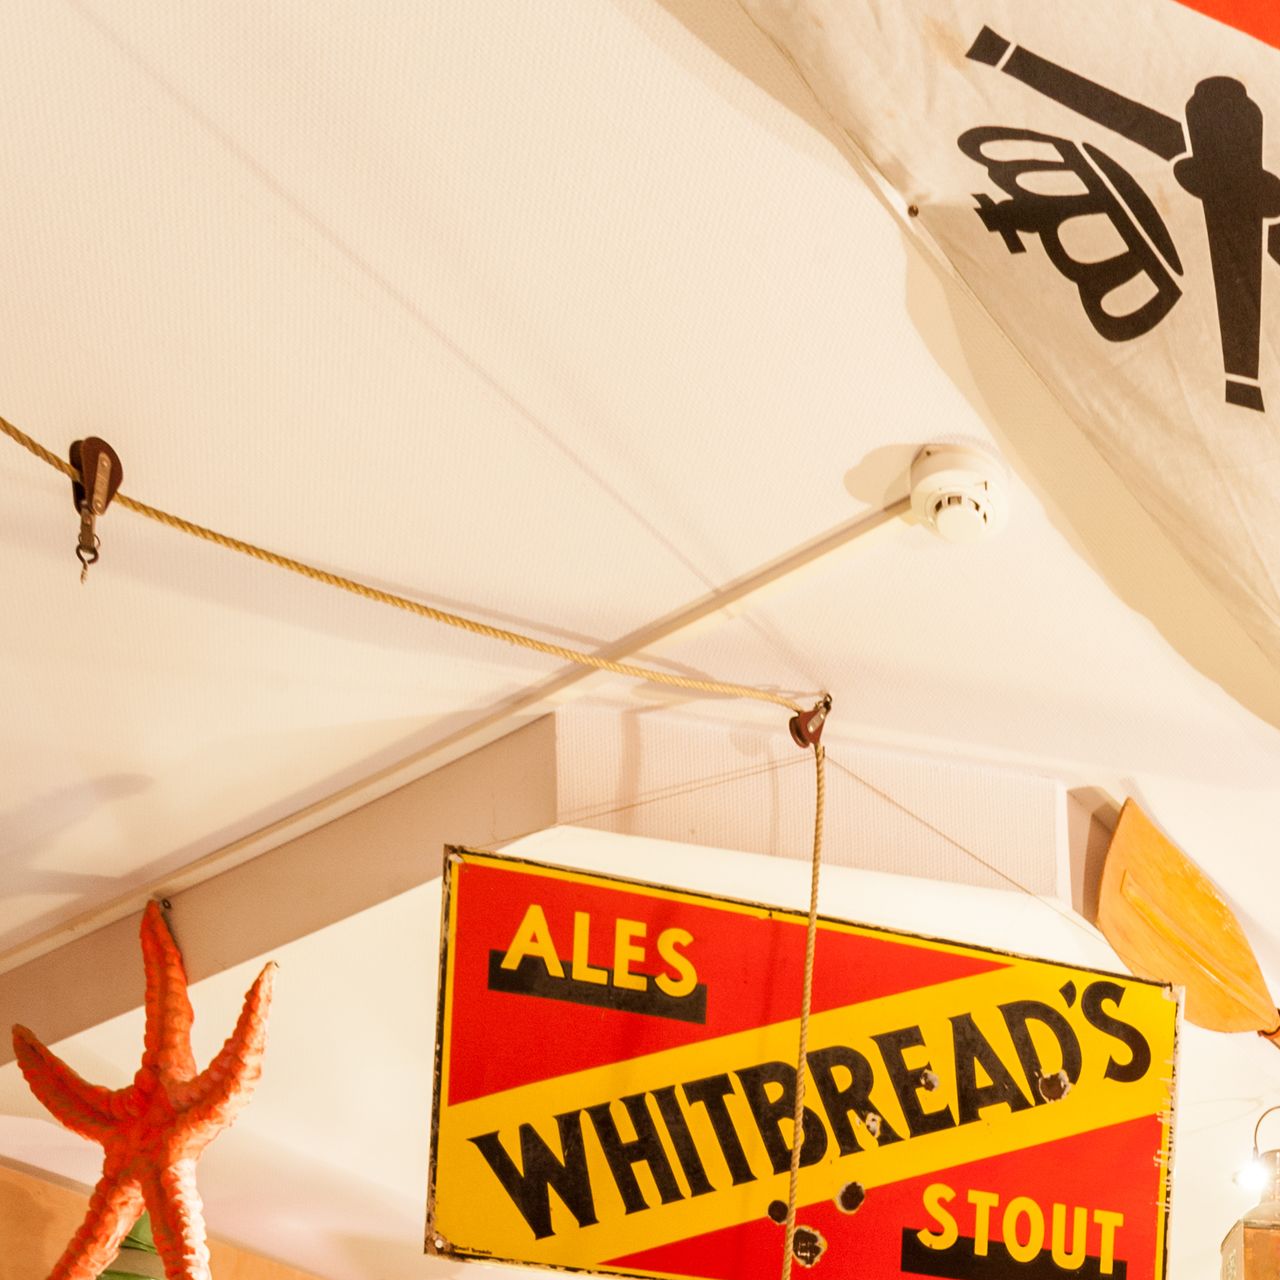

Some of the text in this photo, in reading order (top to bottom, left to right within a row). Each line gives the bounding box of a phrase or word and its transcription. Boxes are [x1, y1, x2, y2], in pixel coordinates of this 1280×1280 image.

[501, 904, 698, 998] ALES
[467, 979, 1152, 1241] WHITBREAD'S
[917, 1184, 1124, 1275] STOUT
